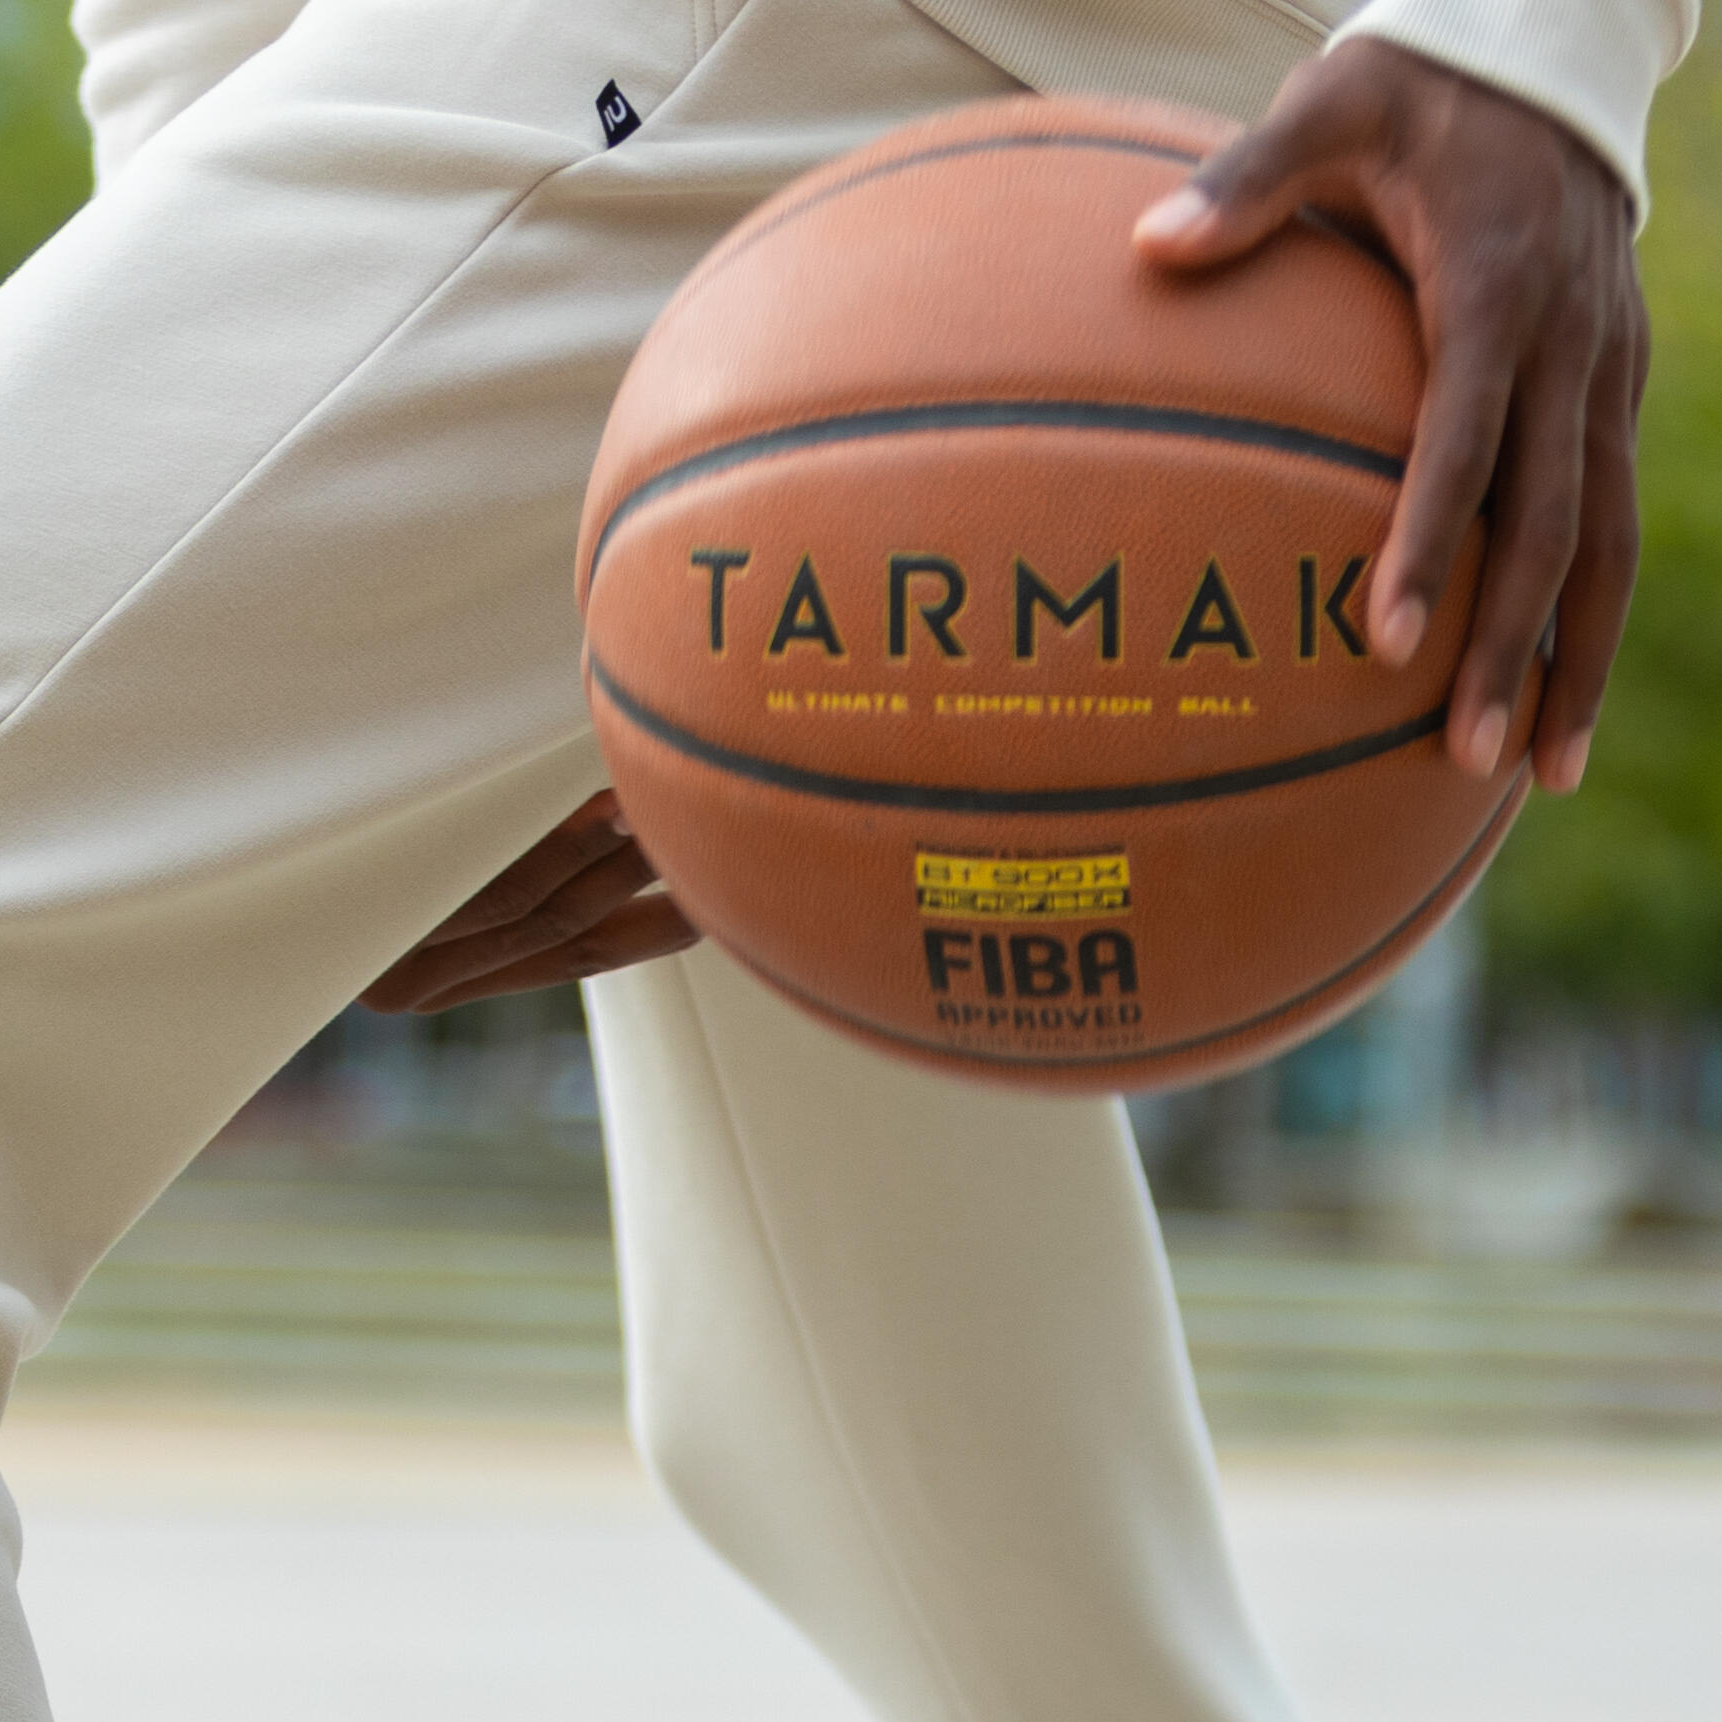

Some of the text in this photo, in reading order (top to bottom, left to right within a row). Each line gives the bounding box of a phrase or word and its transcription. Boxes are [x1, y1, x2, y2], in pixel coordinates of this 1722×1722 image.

[688, 547, 1376, 667] TARMAK
[766, 689, 1257, 717] ULTIMATE COMPETITION BALL
[923, 927, 1139, 998] FIBA
[935, 1000, 1143, 1030] APPROVED
